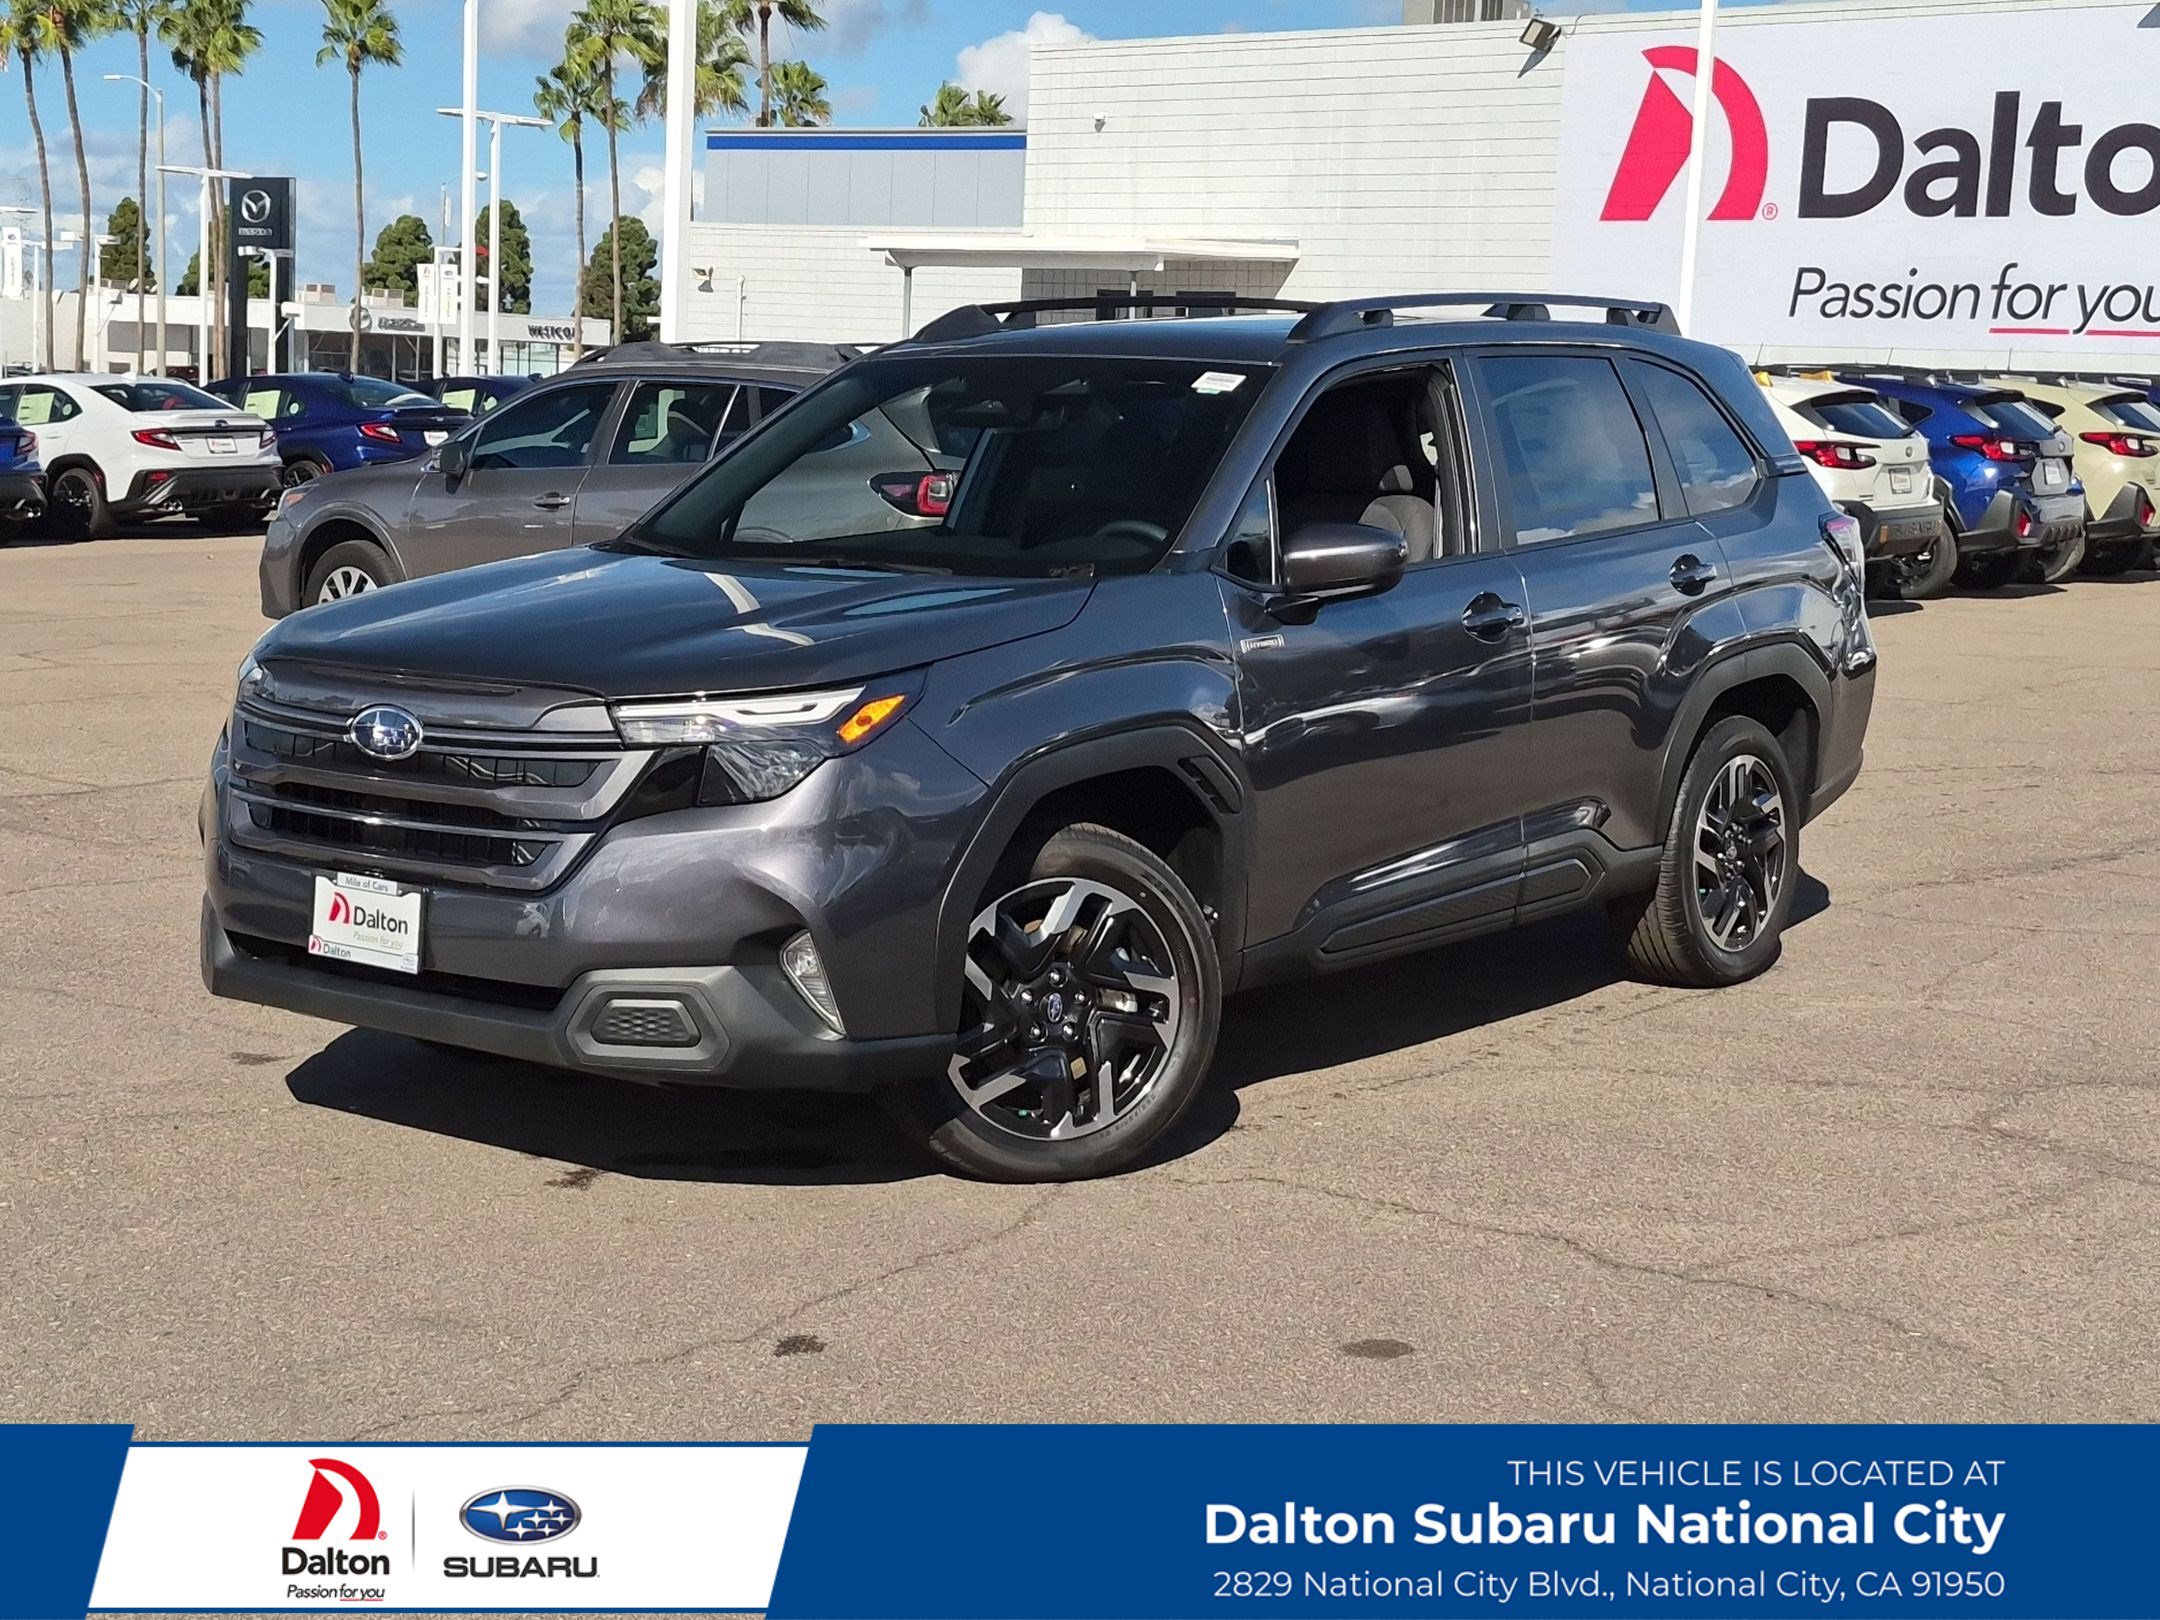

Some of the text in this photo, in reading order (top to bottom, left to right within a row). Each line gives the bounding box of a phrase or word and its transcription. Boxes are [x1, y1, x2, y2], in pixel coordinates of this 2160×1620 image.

[1788, 268, 1980, 320] Passion
[1991, 262, 2068, 321] for
[345, 876, 388, 893] Mile of Cars
[353, 905, 408, 935] Dalton
[353, 930, 404, 949] Passion for you
[323, 942, 352, 959] Dalton
